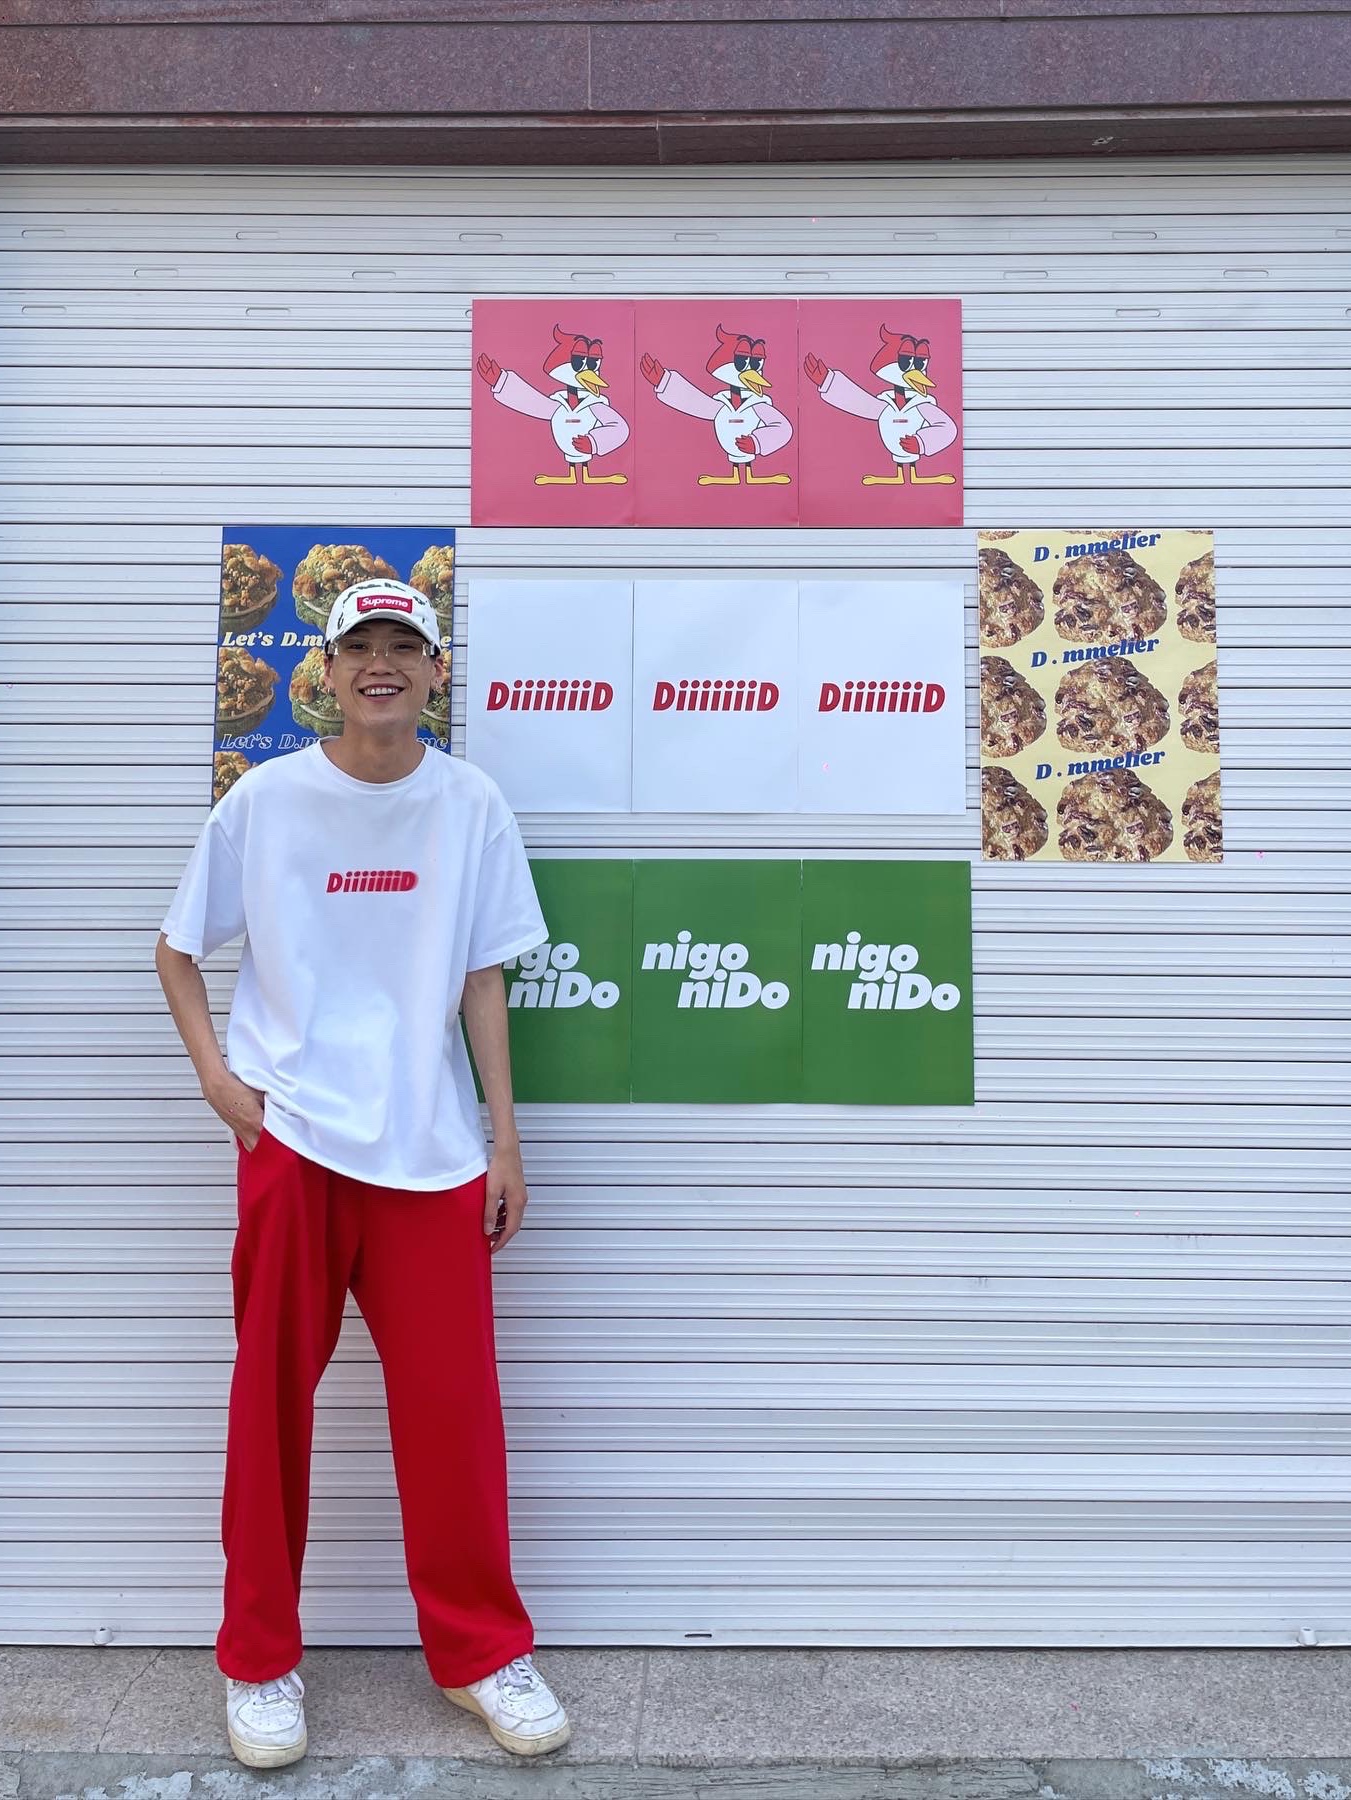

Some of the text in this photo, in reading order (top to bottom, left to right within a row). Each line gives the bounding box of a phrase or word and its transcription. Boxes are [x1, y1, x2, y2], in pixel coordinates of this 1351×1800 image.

[361, 597, 408, 608] Supreme
[221, 631, 274, 647] Let's
[1063, 638, 1159, 664] mmelier
[220, 733, 272, 749] Let's
[1067, 750, 1165, 777] mmelier
[502, 943, 580, 980] go
[641, 930, 749, 981] nigo
[811, 931, 919, 982] nigo
[507, 969, 620, 1009] niDo
[677, 972, 790, 1009] niDo
[847, 972, 961, 1011] niDo
